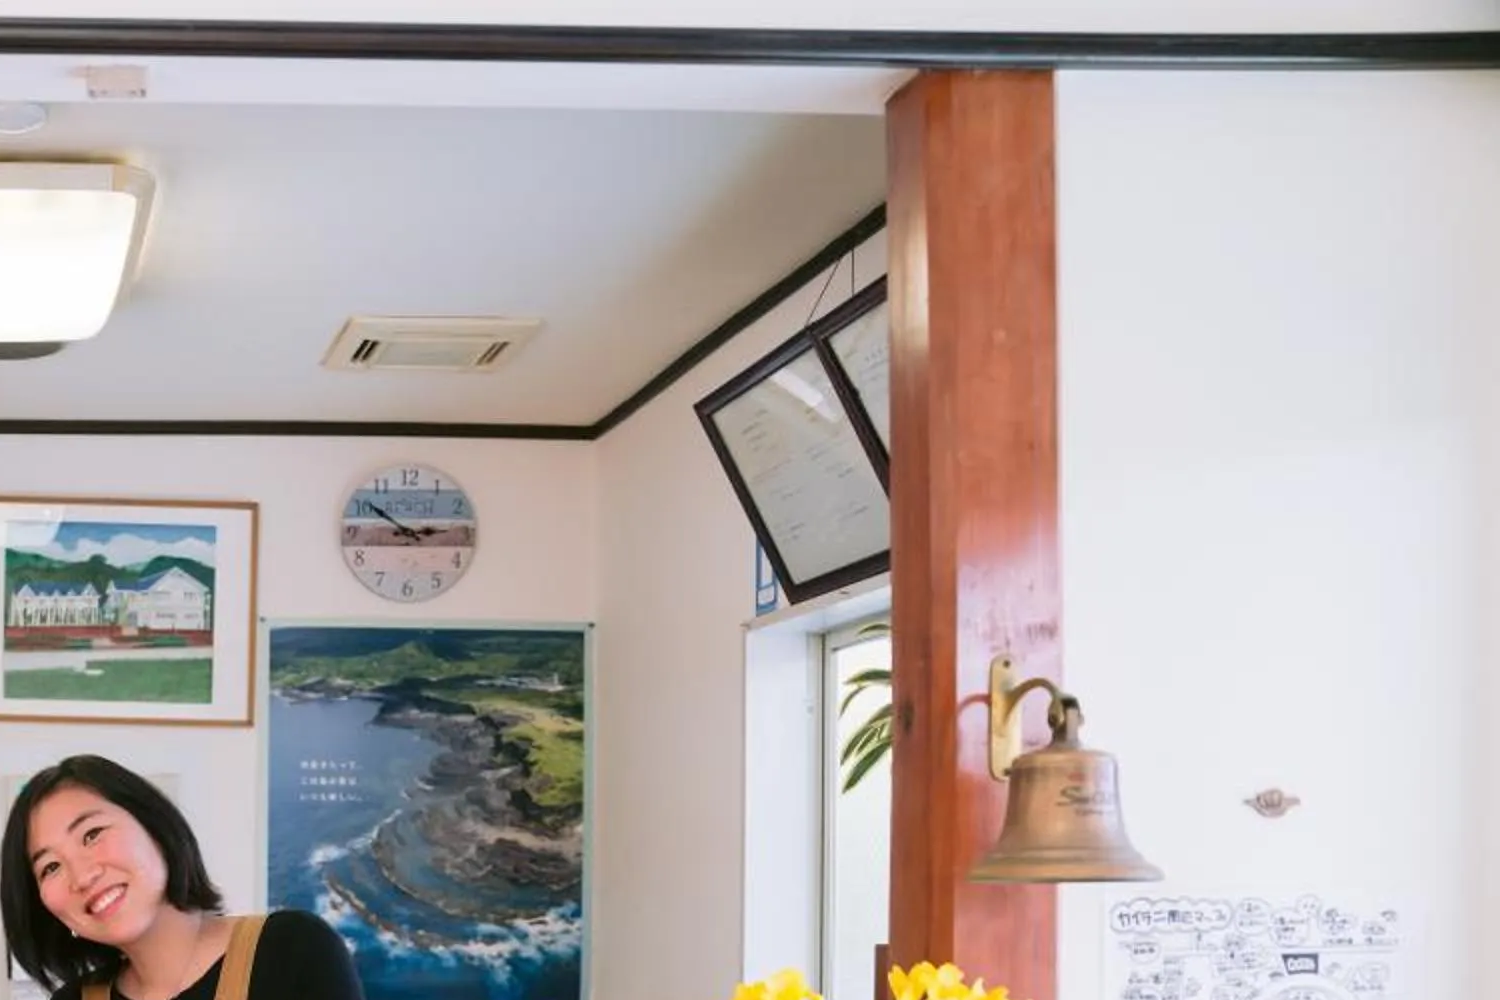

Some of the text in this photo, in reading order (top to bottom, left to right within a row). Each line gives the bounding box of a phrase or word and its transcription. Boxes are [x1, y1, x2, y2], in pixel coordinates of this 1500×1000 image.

[401, 469, 419, 486] 12
[374, 479, 389, 495] 11
[434, 479, 440, 495] 1
[355, 499, 372, 516] 10
[453, 499, 463, 515] 2
[347, 525, 358, 540] 9
[354, 550, 365, 567] 8
[452, 552, 461, 569] 4
[375, 572, 385, 587] 7
[431, 573, 442, 589] 5
[402, 579, 414, 597] 6
